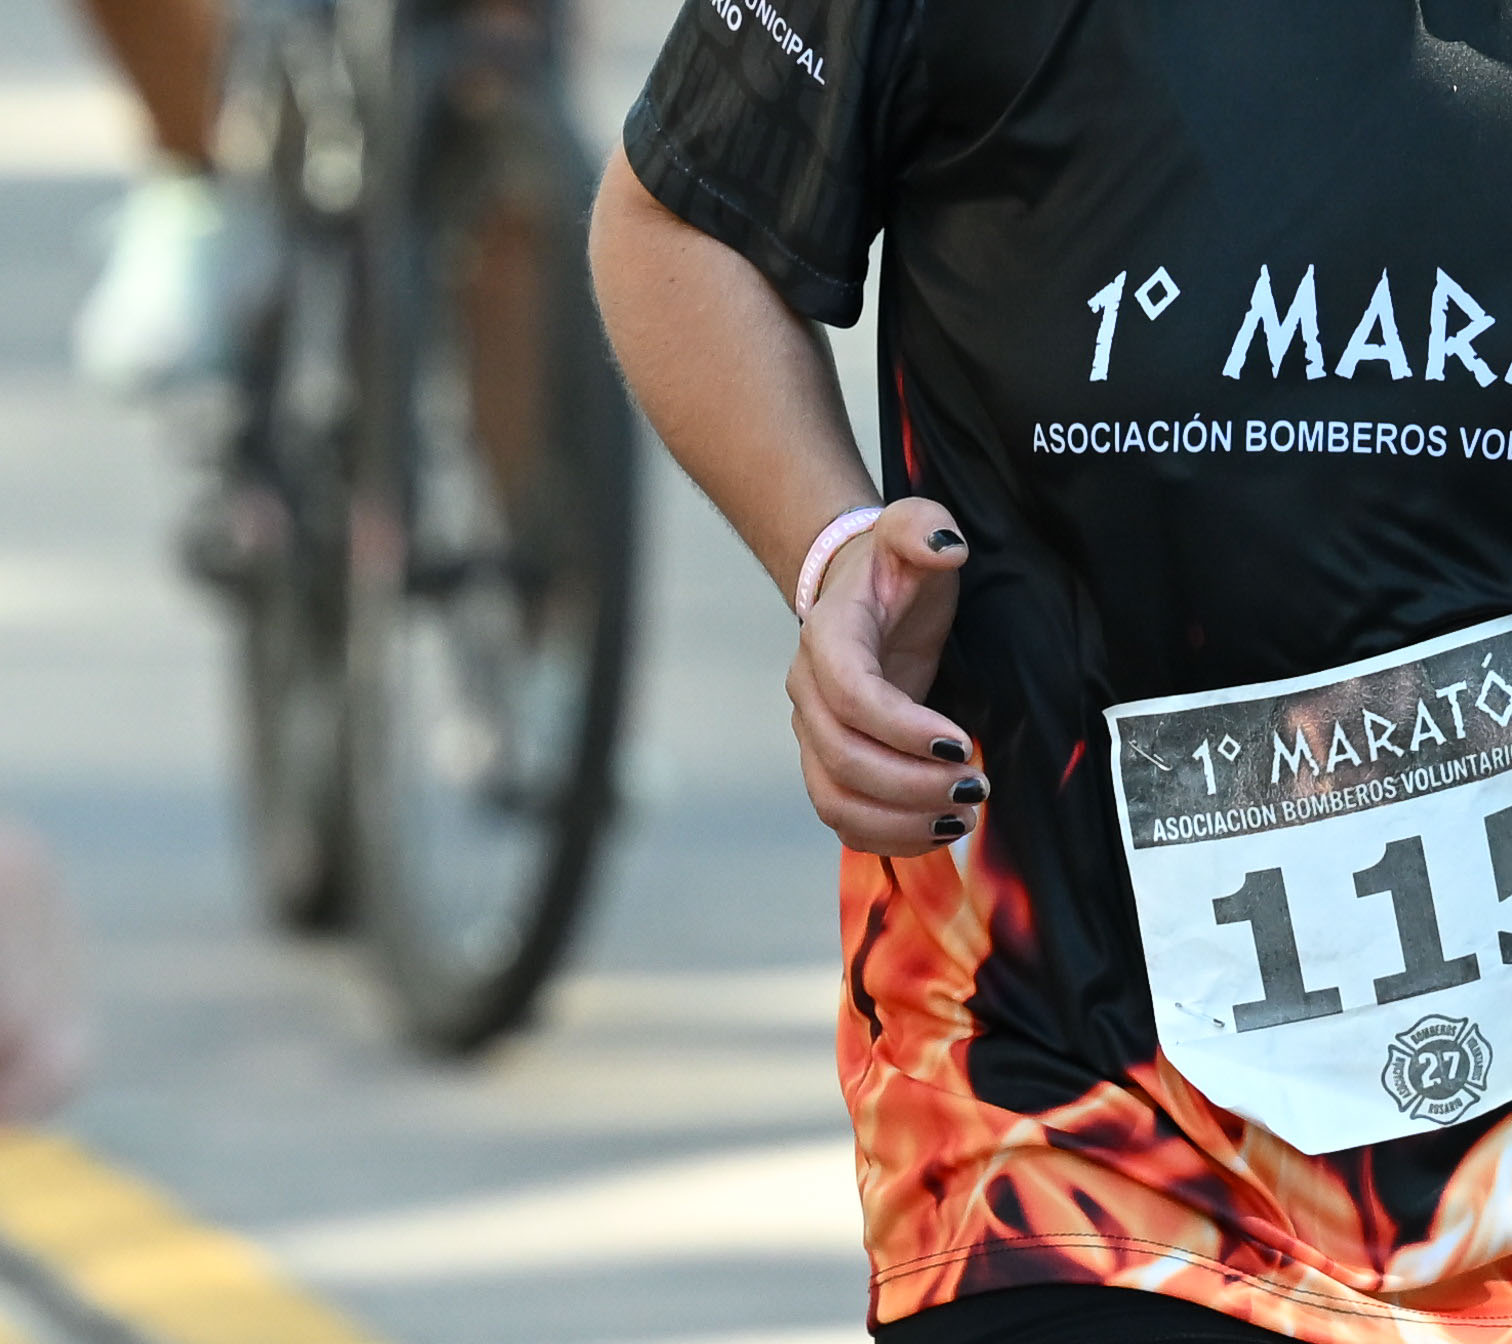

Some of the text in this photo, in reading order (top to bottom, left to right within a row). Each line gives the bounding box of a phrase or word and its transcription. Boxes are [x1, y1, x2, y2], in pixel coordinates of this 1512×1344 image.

[1033, 412, 1232, 455] ASOCIACIÓN
[1245, 419, 1448, 457] BOMBEROS
[1281, 775, 1398, 822] BOMBEROS
[1418, 1051, 1461, 1089] 27
